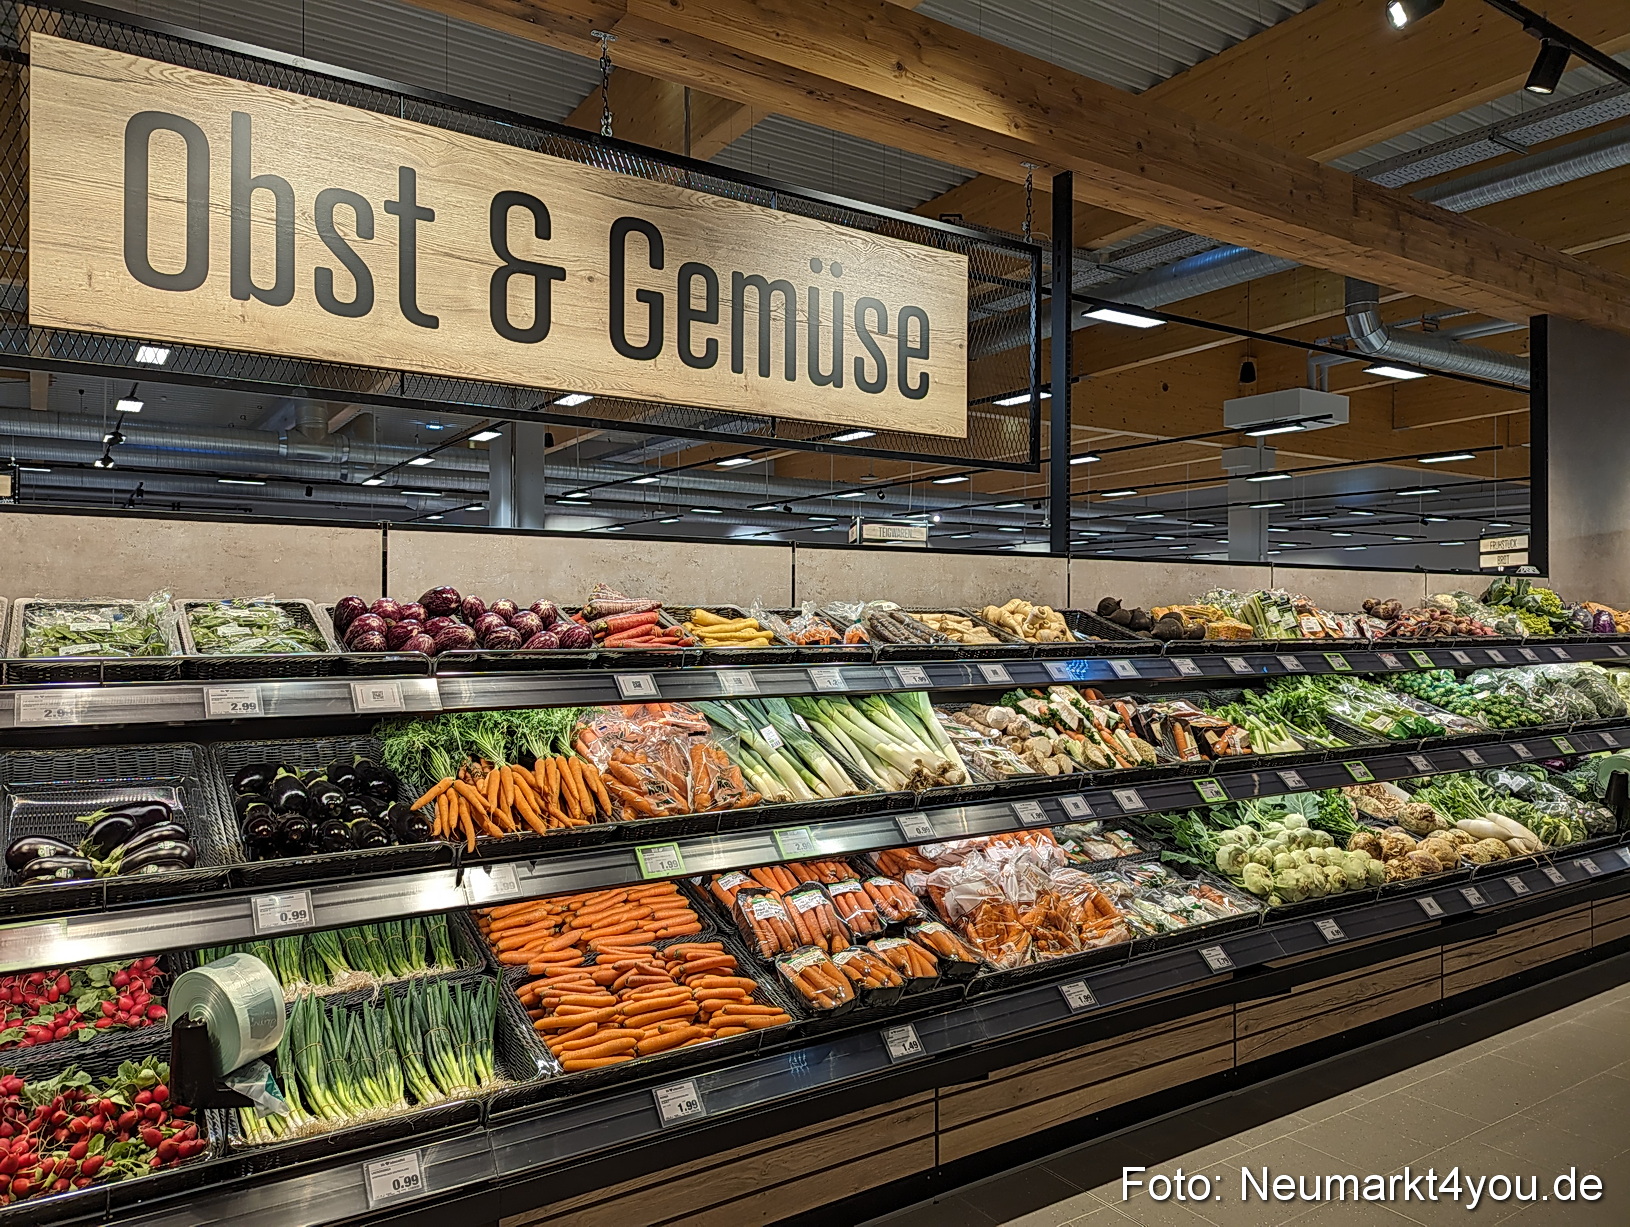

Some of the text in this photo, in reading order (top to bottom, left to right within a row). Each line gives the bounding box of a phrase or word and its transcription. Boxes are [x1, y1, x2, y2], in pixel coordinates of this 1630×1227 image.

[124, 110, 930, 400] Obst & Gemüse
[231, 702, 257, 711] 2.99
[916, 826, 931, 834] 0.99
[659, 860, 678, 869] 1.99
[280, 909, 307, 922] 0.99
[1078, 994, 1092, 1004] 1.99
[902, 1040, 919, 1051] 1.49
[678, 1099, 698, 1112] 1.99
[392, 1174, 419, 1190] 0.99
